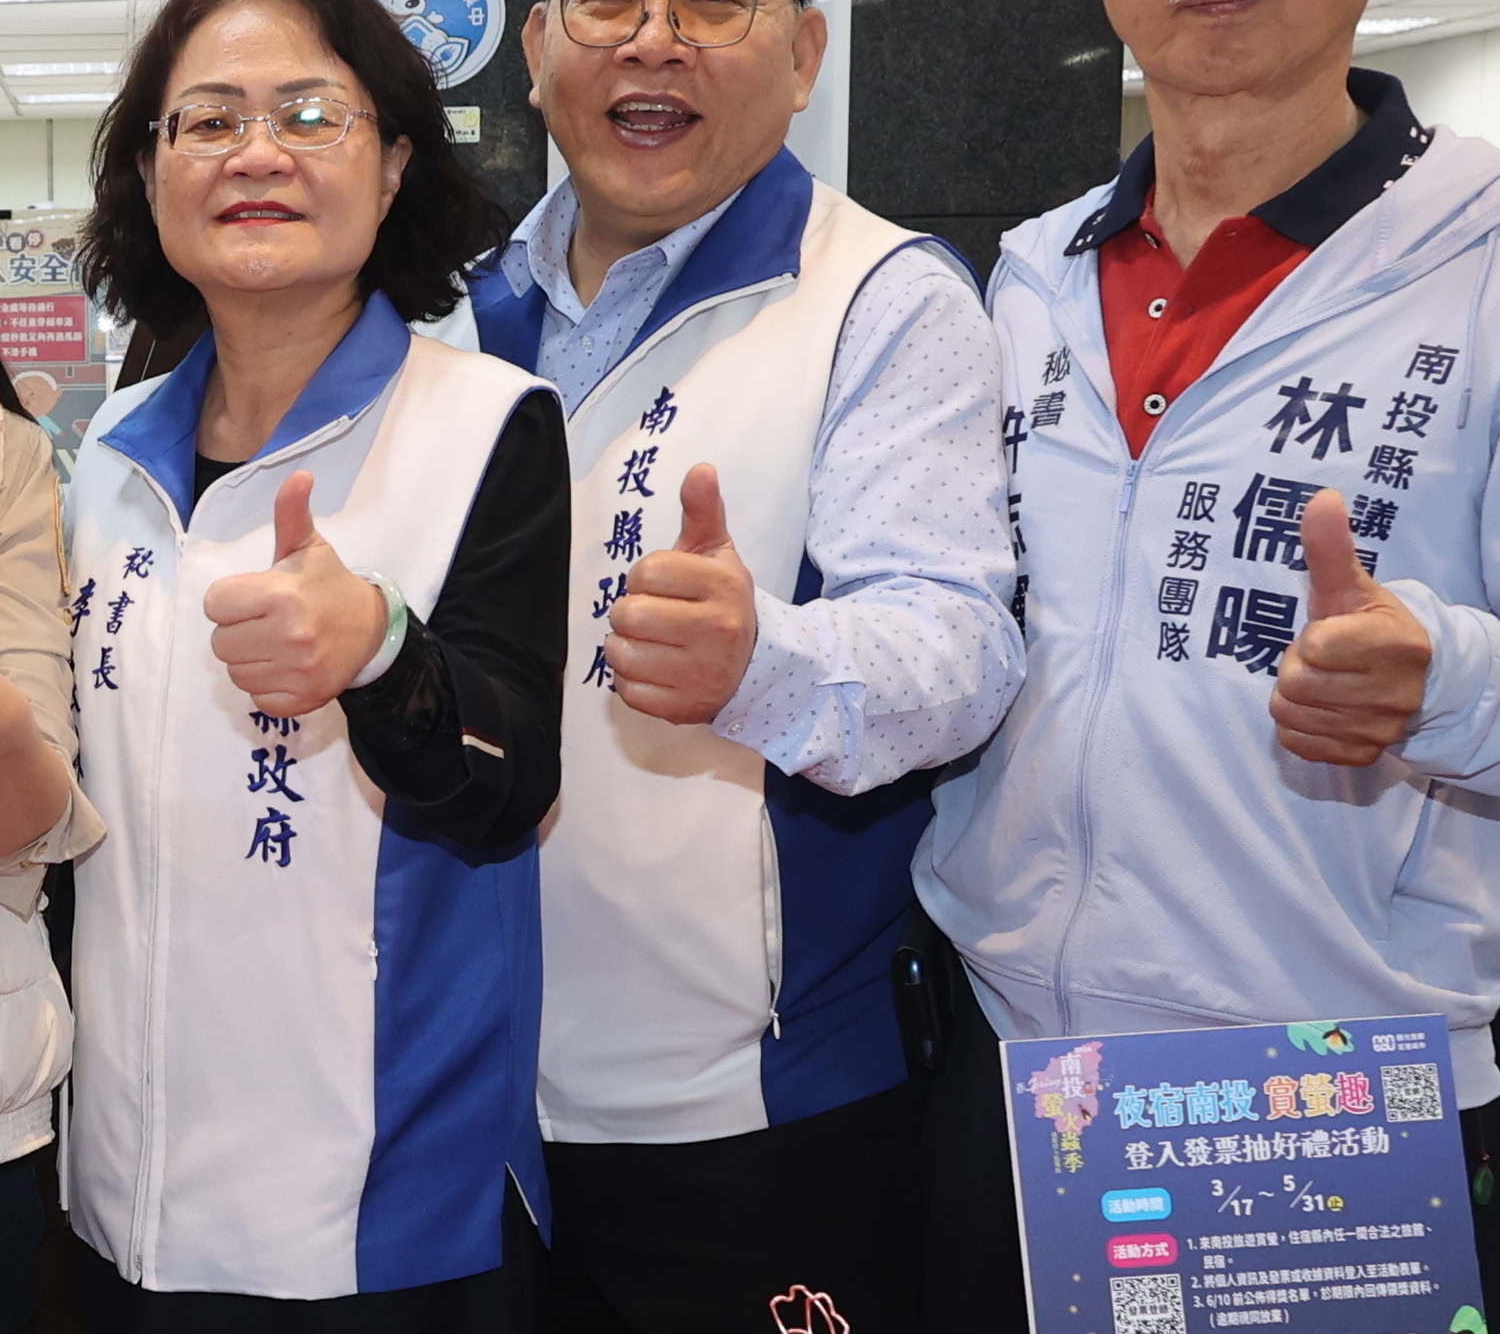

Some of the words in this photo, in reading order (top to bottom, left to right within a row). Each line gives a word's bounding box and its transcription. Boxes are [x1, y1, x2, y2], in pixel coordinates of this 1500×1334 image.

[1157, 481, 1222, 663] 服務團隊
[1059, 1053, 1086, 1099] 南投
[1112, 1080, 1260, 1131] 夜宿南投
[1263, 1071, 1376, 1121] 賞螢趣
[1124, 1125, 1390, 1172] 登入發票抽好禮活動
[1112, 1239, 1170, 1261] 活動方式
